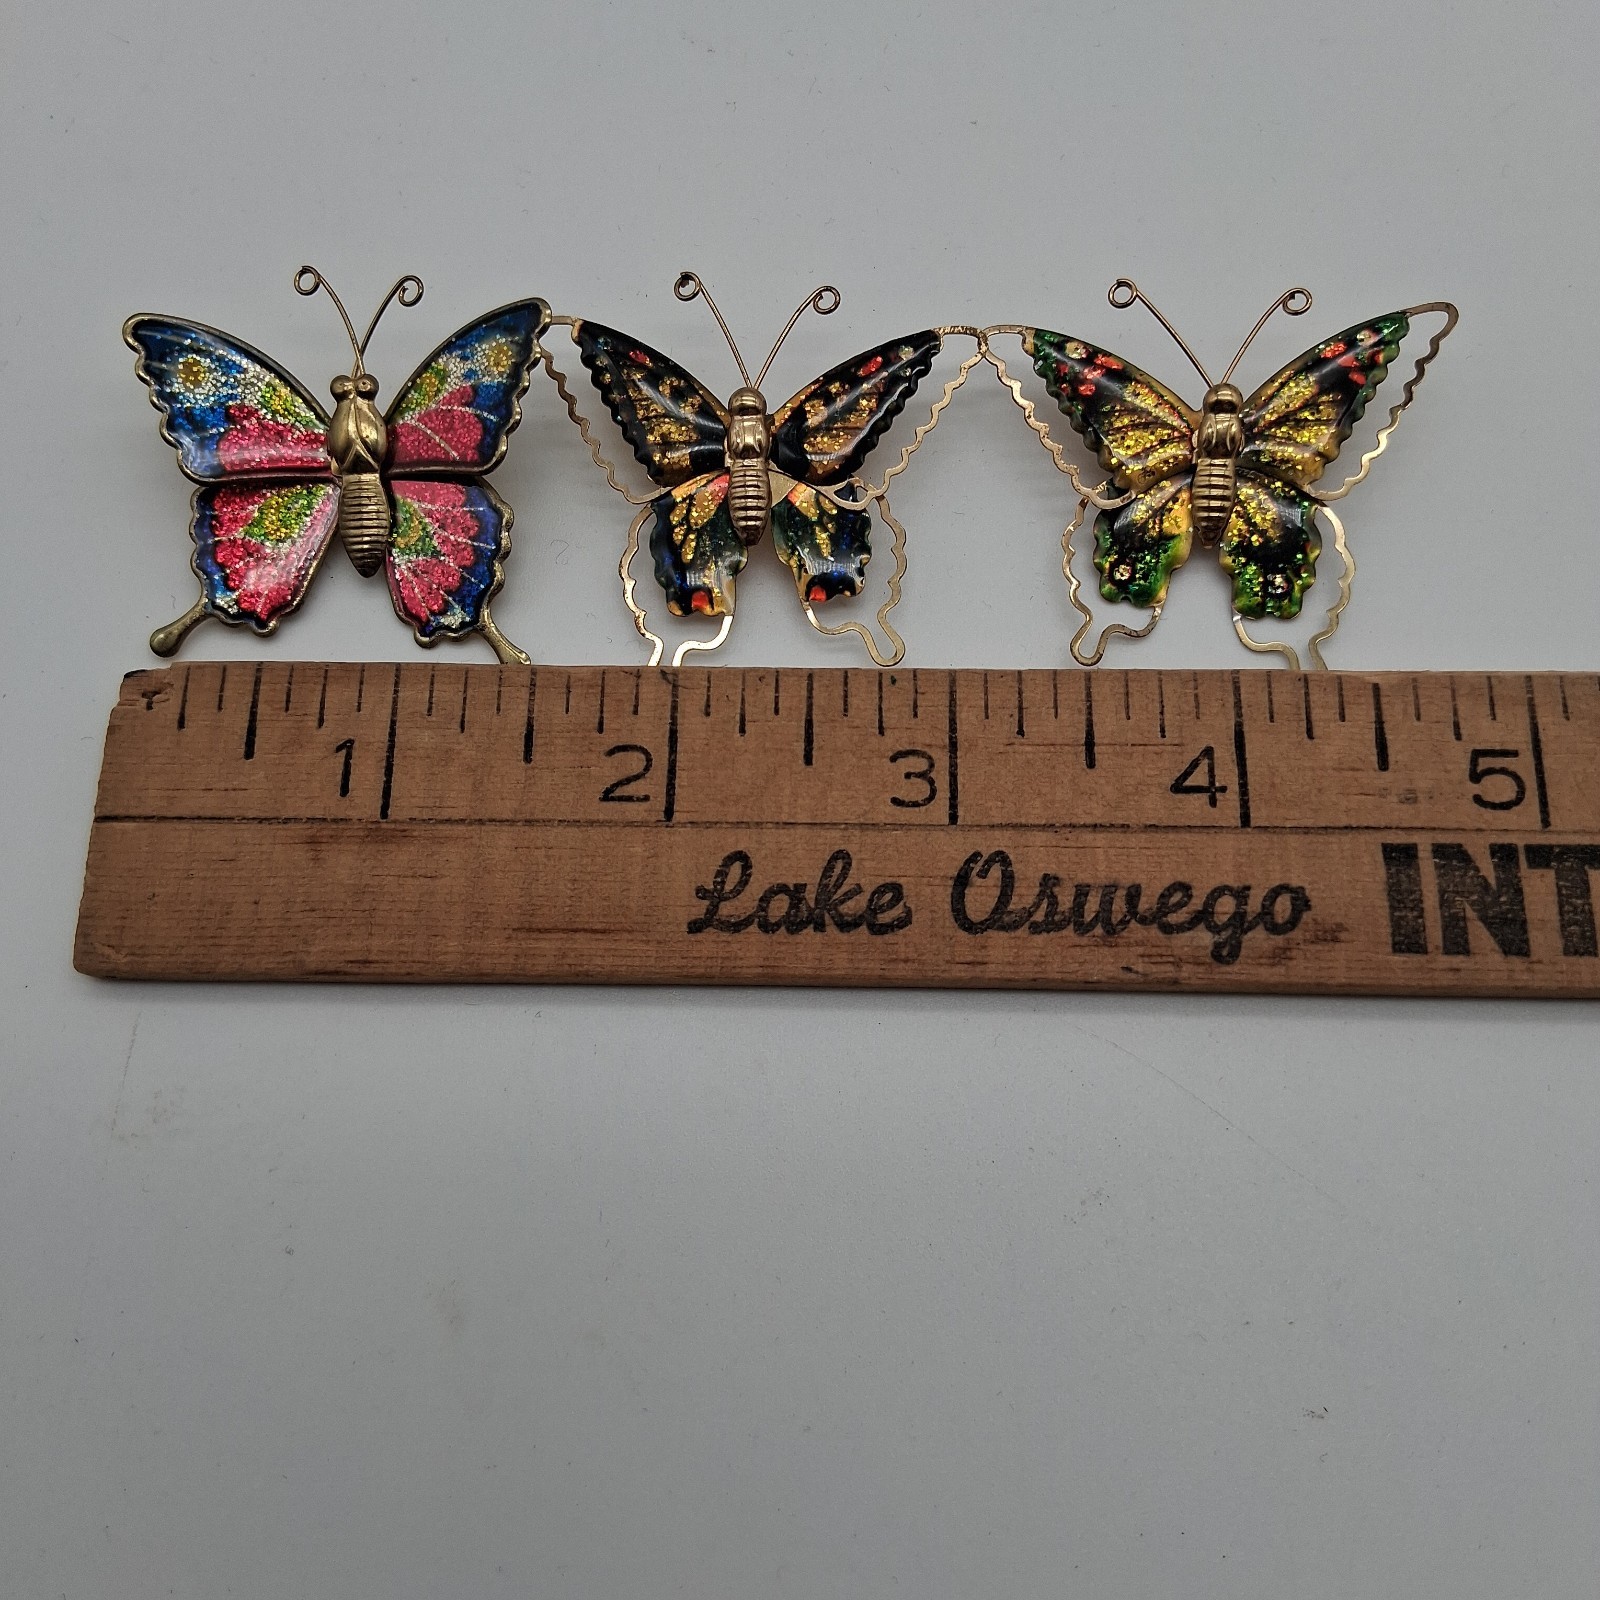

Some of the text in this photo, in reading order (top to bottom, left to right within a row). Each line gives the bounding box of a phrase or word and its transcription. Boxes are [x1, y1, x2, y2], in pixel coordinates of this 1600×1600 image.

[333, 738, 1527, 811] 1 2 3 4 5
[686, 842, 1600, 965] Lake Oswego INT
